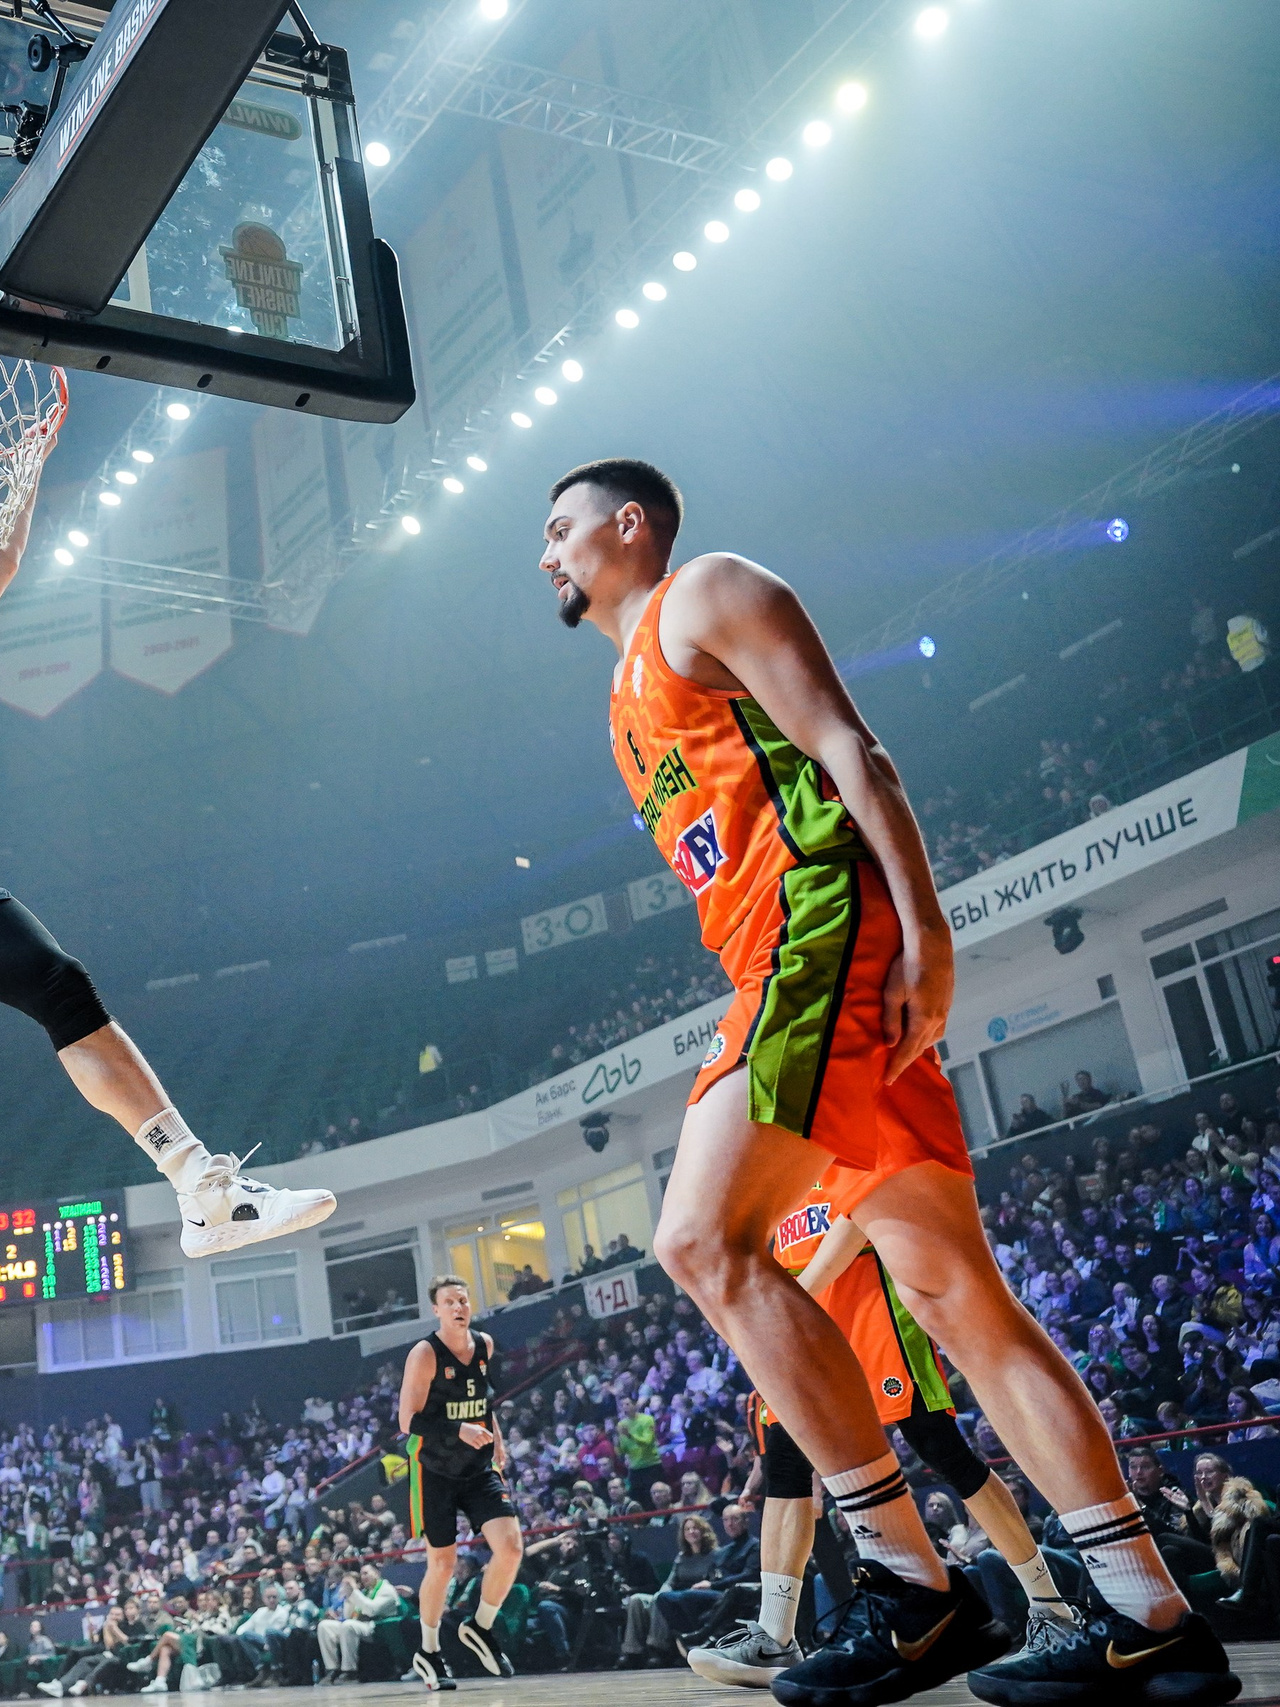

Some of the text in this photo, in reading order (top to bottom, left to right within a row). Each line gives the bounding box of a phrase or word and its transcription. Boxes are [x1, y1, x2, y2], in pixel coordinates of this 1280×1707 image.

[59, 47, 113, 158] WINLINE
[994, 858, 1077, 912] ЖИТЬ
[1084, 797, 1199, 872] ЛУЧШЕ
[12, 1209, 36, 1228] 32
[780, 1204, 831, 1250] BROZEX
[467, 1379, 476, 1397] 5
